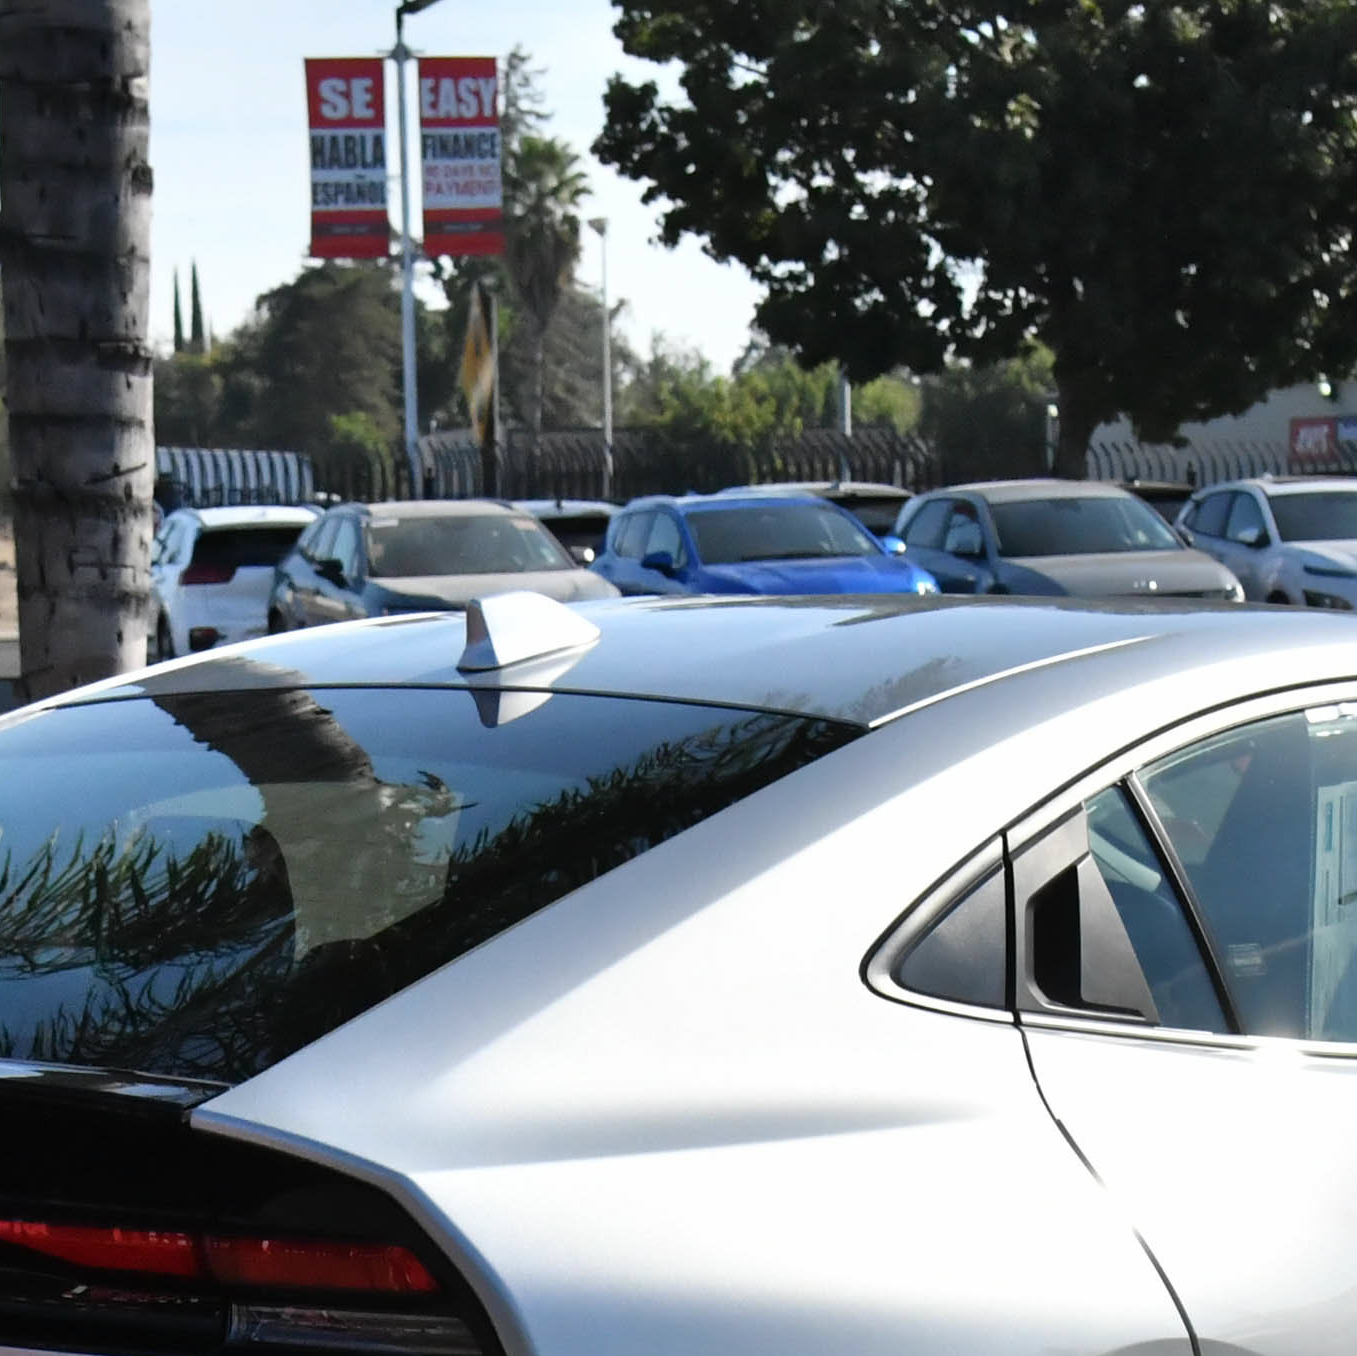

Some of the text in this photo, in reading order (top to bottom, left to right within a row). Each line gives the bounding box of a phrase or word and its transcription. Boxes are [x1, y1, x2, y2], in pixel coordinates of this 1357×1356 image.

[318, 77, 375, 119] SE
[421, 77, 497, 118] EASY
[311, 135, 385, 170] HABLA
[422, 132, 497, 160] FINANCE
